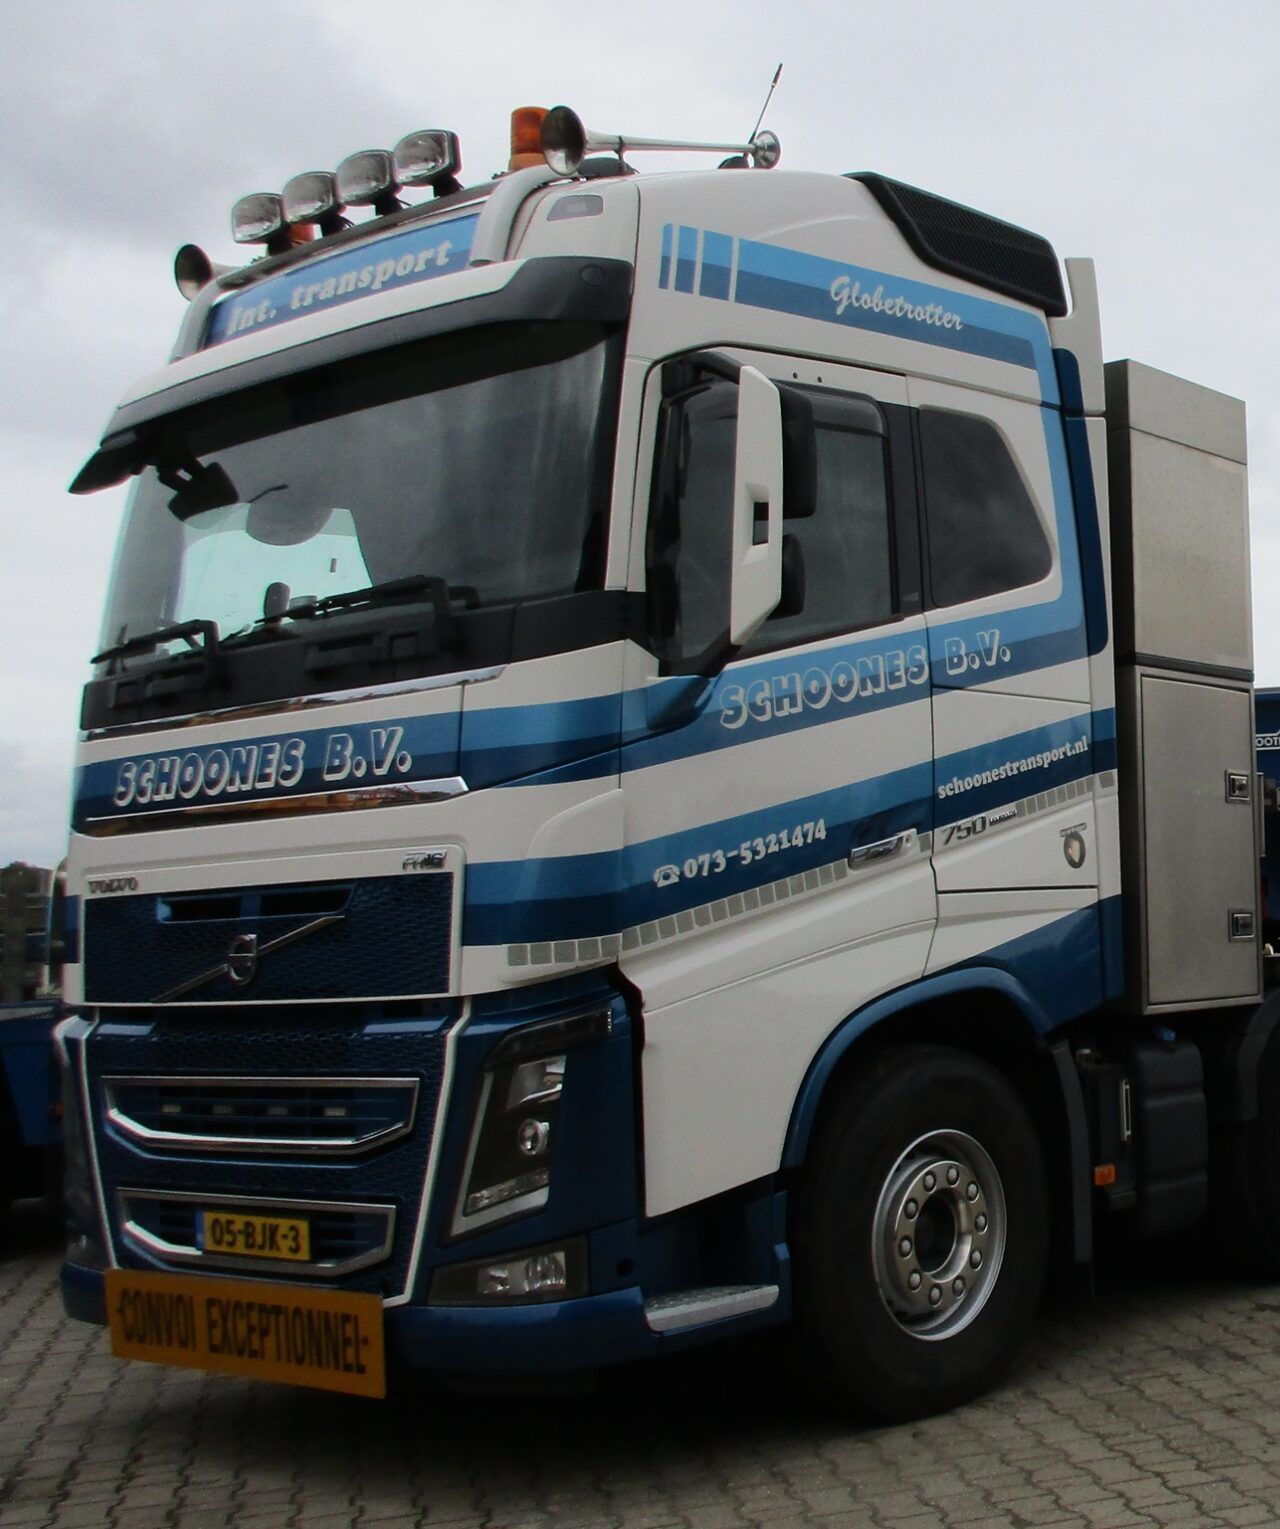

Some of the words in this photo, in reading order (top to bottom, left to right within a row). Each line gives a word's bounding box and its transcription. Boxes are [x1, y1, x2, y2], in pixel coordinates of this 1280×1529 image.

[226, 299, 277, 336] Int.
[290, 239, 454, 311] transport
[830, 275, 964, 331] Globetrotter
[718, 645, 930, 730] SCHOONES
[944, 629, 1012, 676] B.V.
[114, 738, 306, 807] SCHOONES
[322, 726, 413, 782] B.V.
[937, 735, 1089, 799] schoonestransport.nl
[683, 818, 827, 879] 073-5321474
[942, 816, 987, 846] 750
[211, 1217, 302, 1254] 05-BJK-3
[121, 1288, 198, 1352] CONVOI
[206, 1298, 367, 1376] EXCEPTIONNEL
